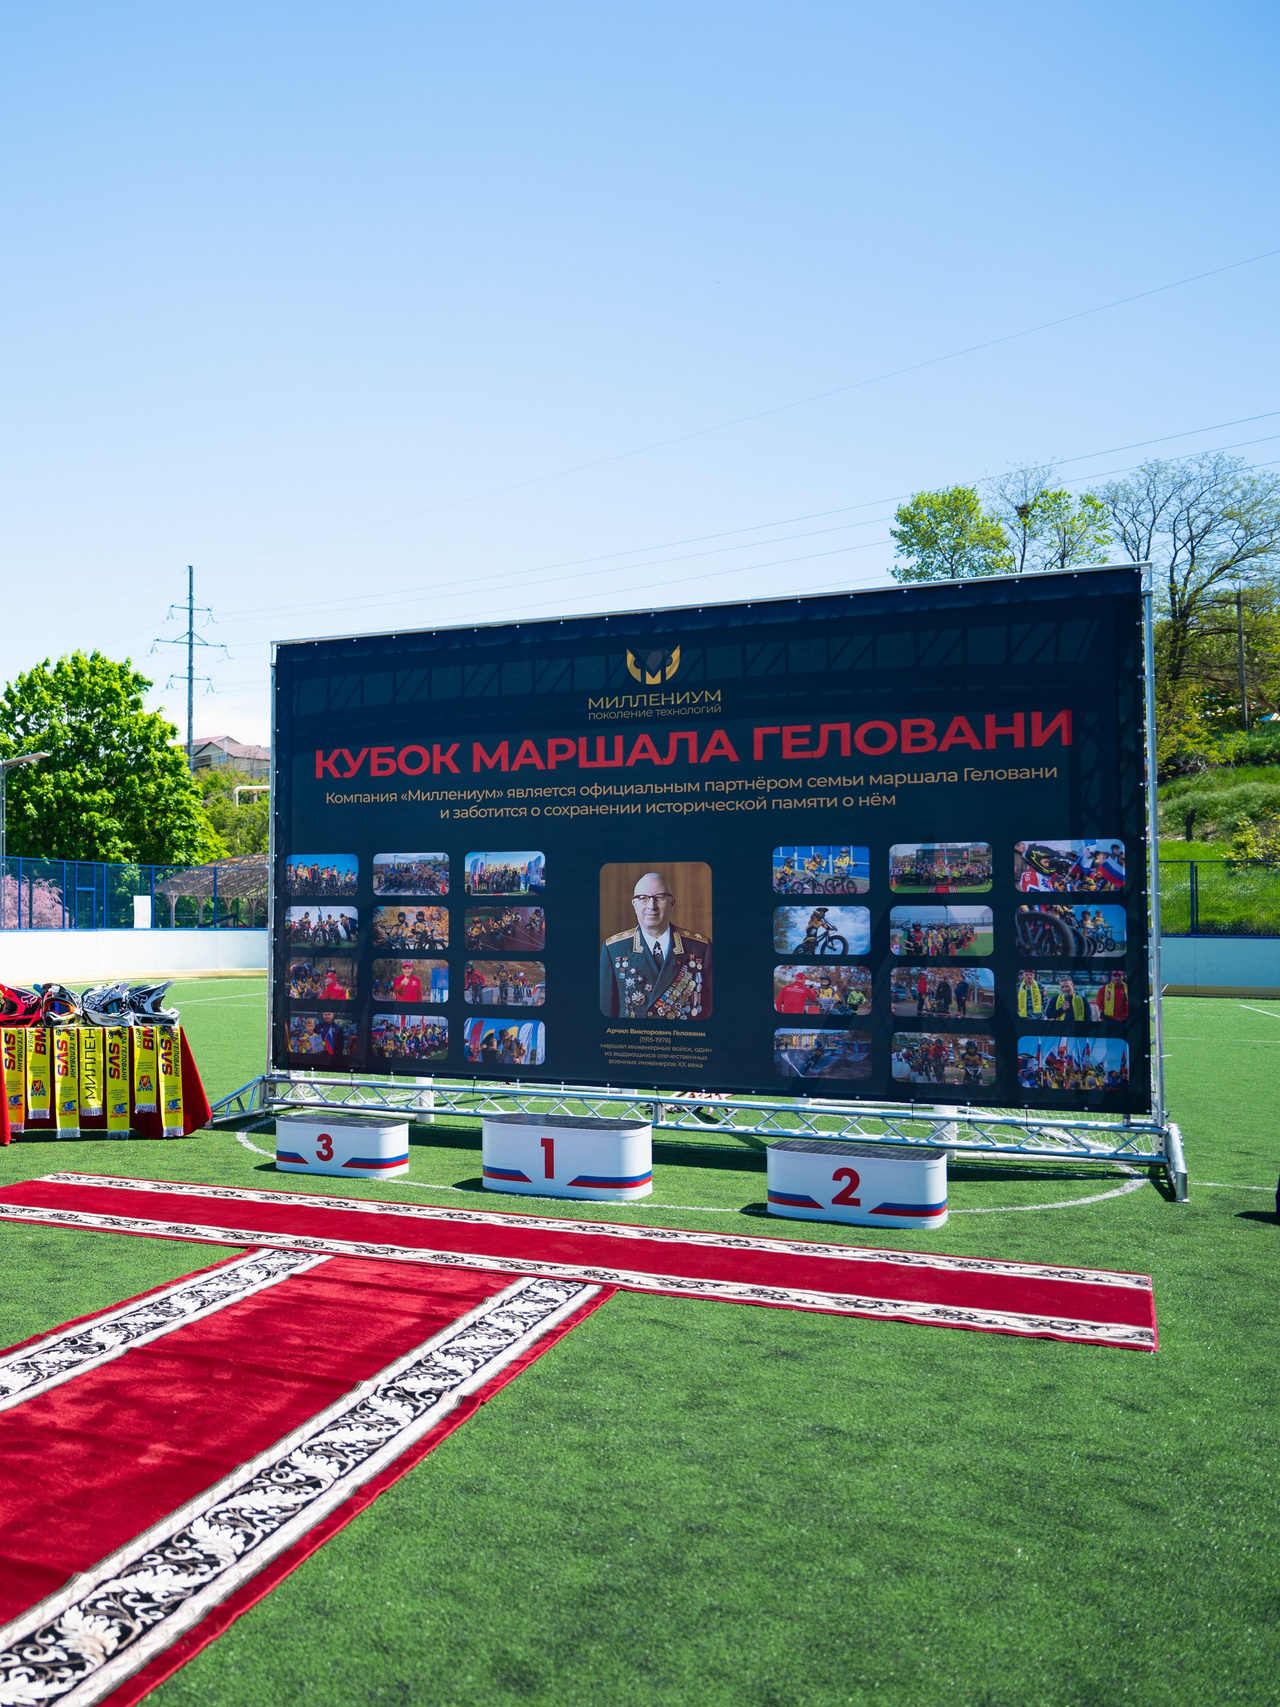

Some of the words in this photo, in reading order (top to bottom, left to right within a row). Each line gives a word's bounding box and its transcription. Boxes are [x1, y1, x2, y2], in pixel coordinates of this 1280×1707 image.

[588, 689, 722, 710] МИЛЛЕНИУМ
[588, 708, 653, 720] поколение
[655, 704, 722, 717] технологий
[315, 743, 461, 779] КУБОК
[472, 729, 740, 773] МАРШАЛА
[753, 709, 1073, 762] ГЕЛОВАНИ
[325, 791, 398, 804] Компания
[400, 788, 504, 803] «Миллениум»
[506, 785, 576, 798] является
[579, 780, 701, 799] официальным
[704, 775, 803, 795] партнёром
[806, 774, 864, 788] семьи
[869, 768, 958, 788] маршала
[963, 766, 1058, 782] Геловани
[440, 809, 450, 819] и
[452, 804, 528, 819] заботится
[530, 806, 541, 816] о
[544, 803, 642, 819] сохранении
[645, 797, 767, 815] исторической
[771, 794, 838, 810] памяти
[842, 796, 854, 807] о
[858, 792, 897, 807] нём
[630, 1028, 671, 1036] Викторович
[627, 1044, 671, 1052] инженерных
[656, 1053, 708, 1061] отечественных
[315, 1133, 334, 1162] 3
[540, 1138, 555, 1179] 1
[831, 1167, 861, 1207] 2
